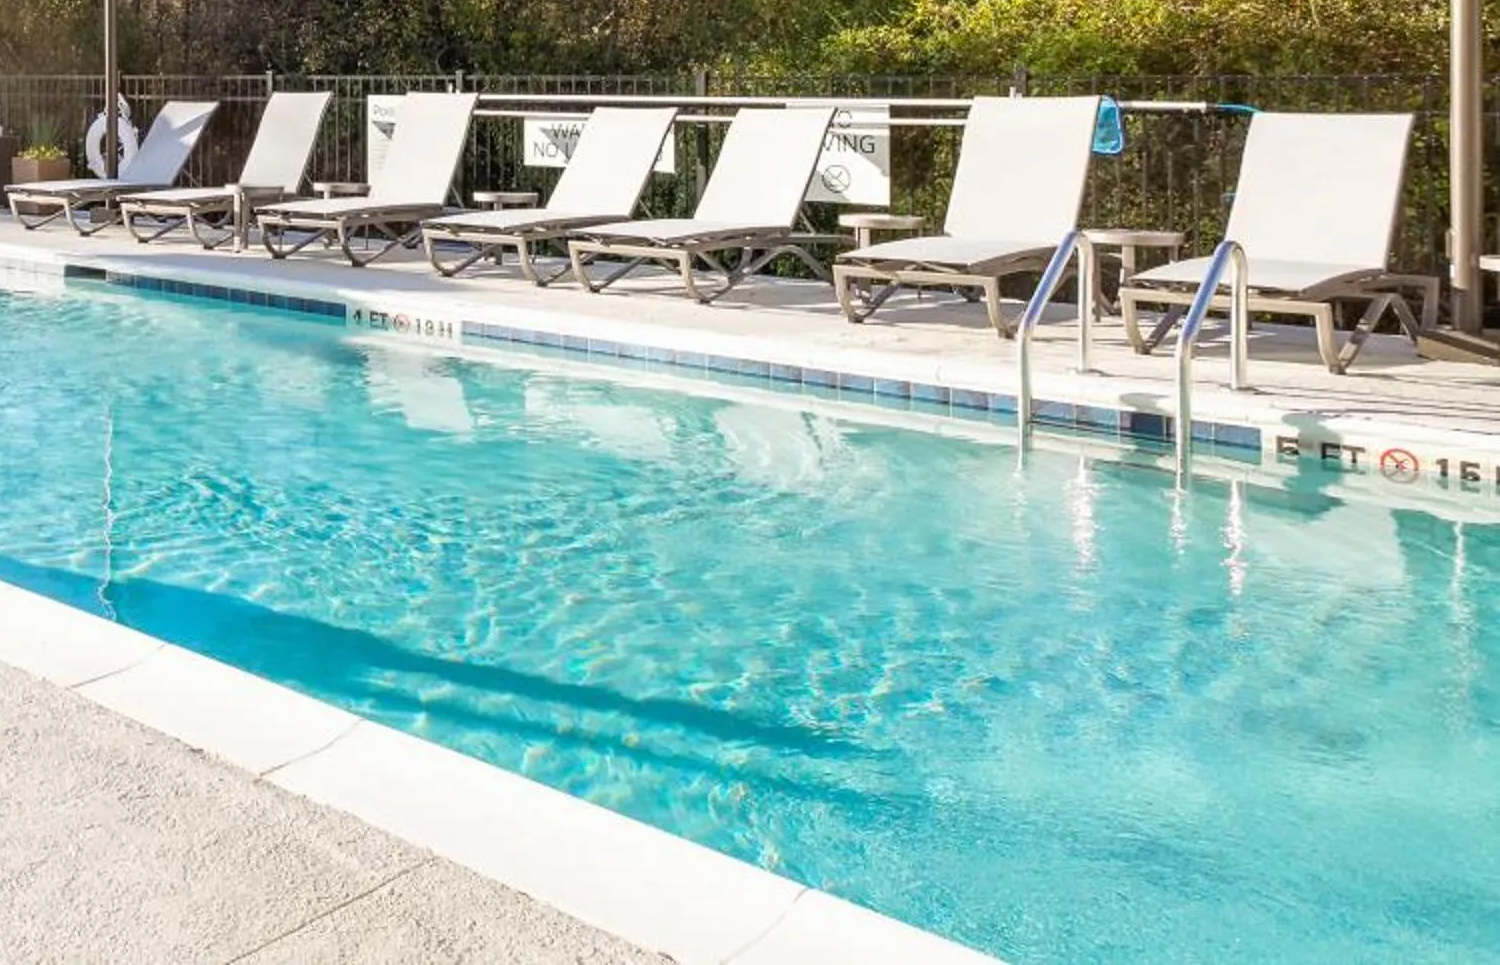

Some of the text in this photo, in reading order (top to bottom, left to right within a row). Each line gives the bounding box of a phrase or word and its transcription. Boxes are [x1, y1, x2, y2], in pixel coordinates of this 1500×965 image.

[533, 141, 558, 157] NO
[823, 133, 875, 154] VING
[1321, 442, 1366, 465] FT
